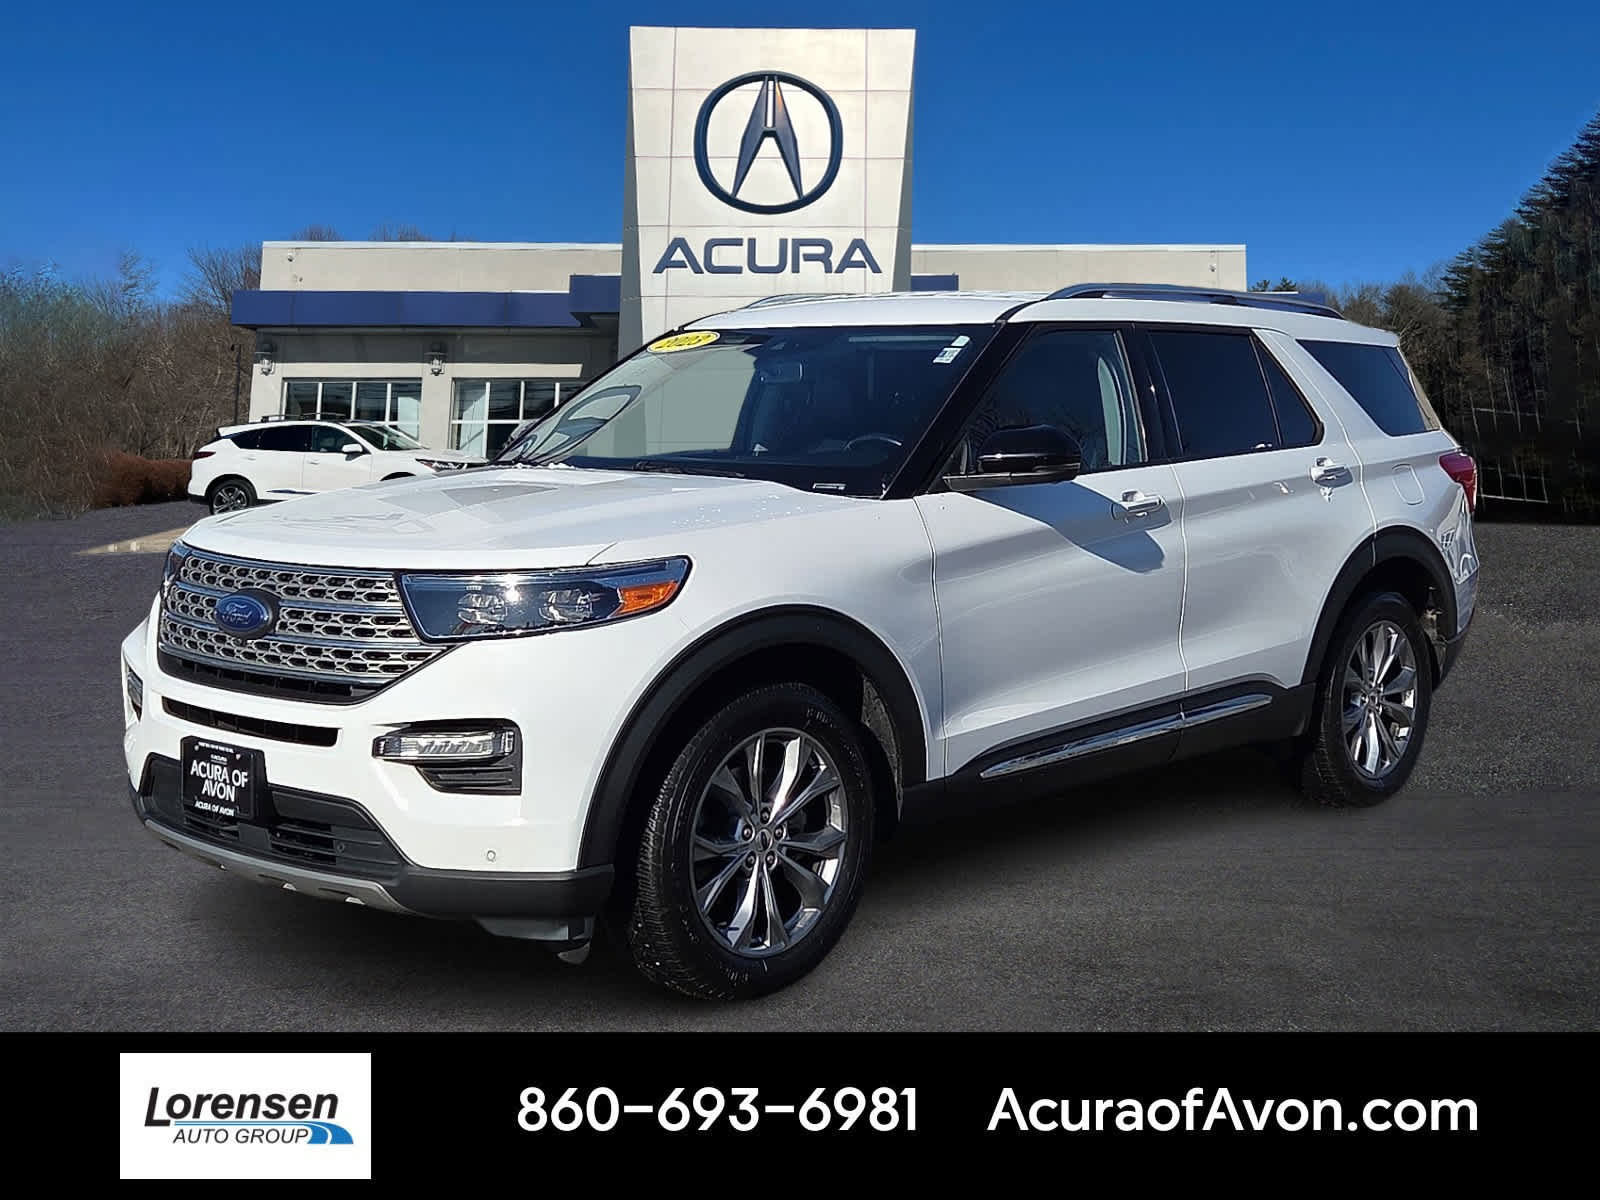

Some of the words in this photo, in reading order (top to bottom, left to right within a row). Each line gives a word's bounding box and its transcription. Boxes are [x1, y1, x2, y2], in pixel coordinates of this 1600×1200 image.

[653, 237, 883, 275] ACURA
[190, 759, 230, 784] ACURA
[231, 769, 249, 788] OF
[201, 779, 236, 802] AVON
[194, 800, 211, 810] ACURA
[211, 804, 220, 813] OF
[219, 806, 235, 817] AVON
